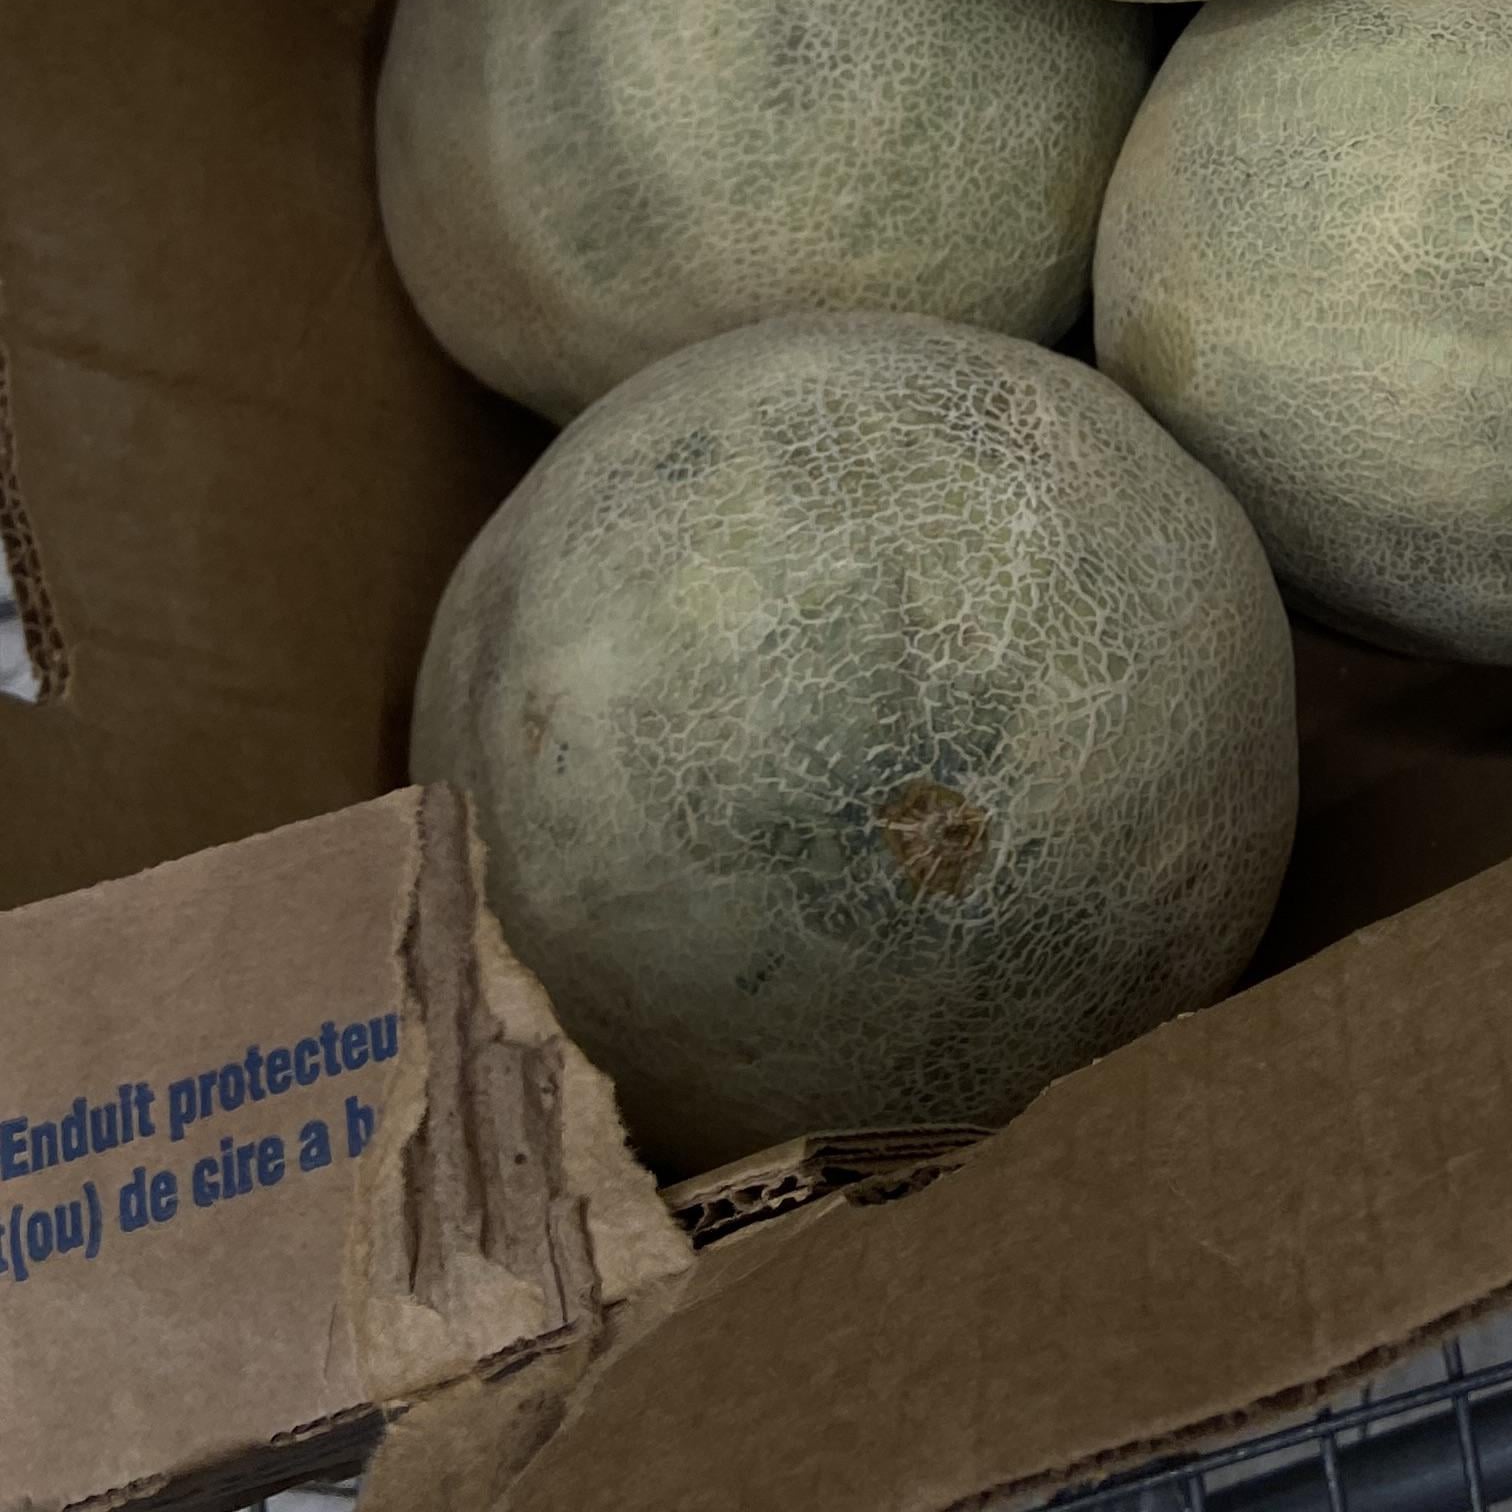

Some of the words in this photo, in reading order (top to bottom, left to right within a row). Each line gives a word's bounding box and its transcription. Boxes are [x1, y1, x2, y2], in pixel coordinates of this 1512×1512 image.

[0, 1082, 155, 1181] Enduit
[119, 1166, 178, 1232] de
[192, 1130, 284, 1207] cire
[299, 1120, 332, 1172] a
